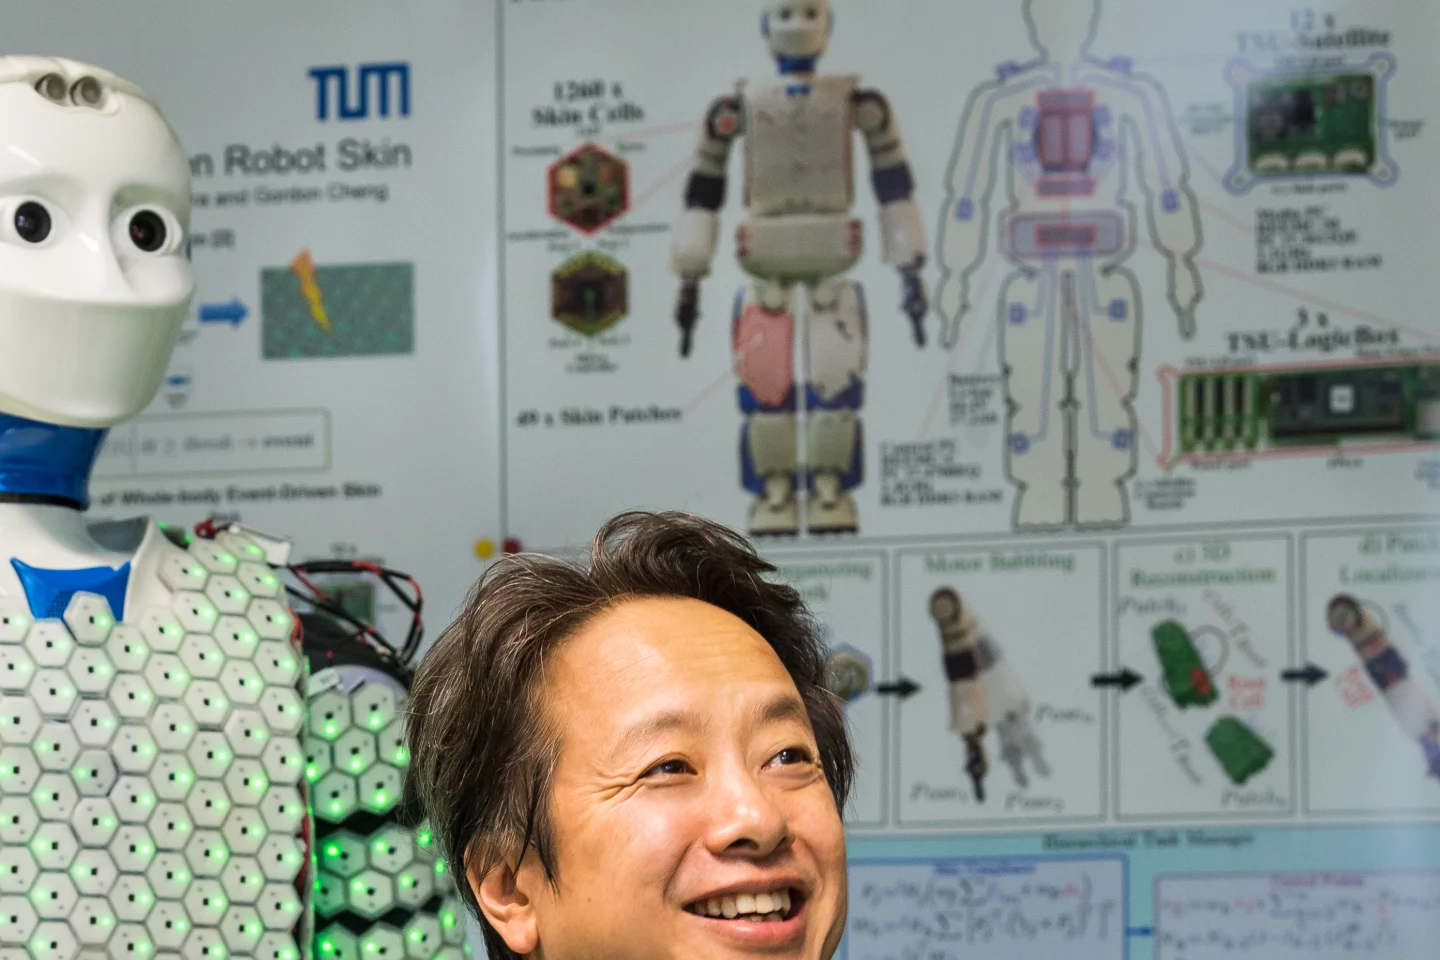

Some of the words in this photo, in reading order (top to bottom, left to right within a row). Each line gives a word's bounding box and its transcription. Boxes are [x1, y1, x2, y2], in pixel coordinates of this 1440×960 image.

[307, 61, 411, 122] TUM
[531, 106, 582, 127] Skin
[589, 101, 645, 122] Cells
[225, 143, 326, 176] Robot
[337, 139, 412, 170] Skin
[215, 189, 249, 207] and
[559, 405, 603, 426] Skin
[609, 402, 682, 422] Patches
